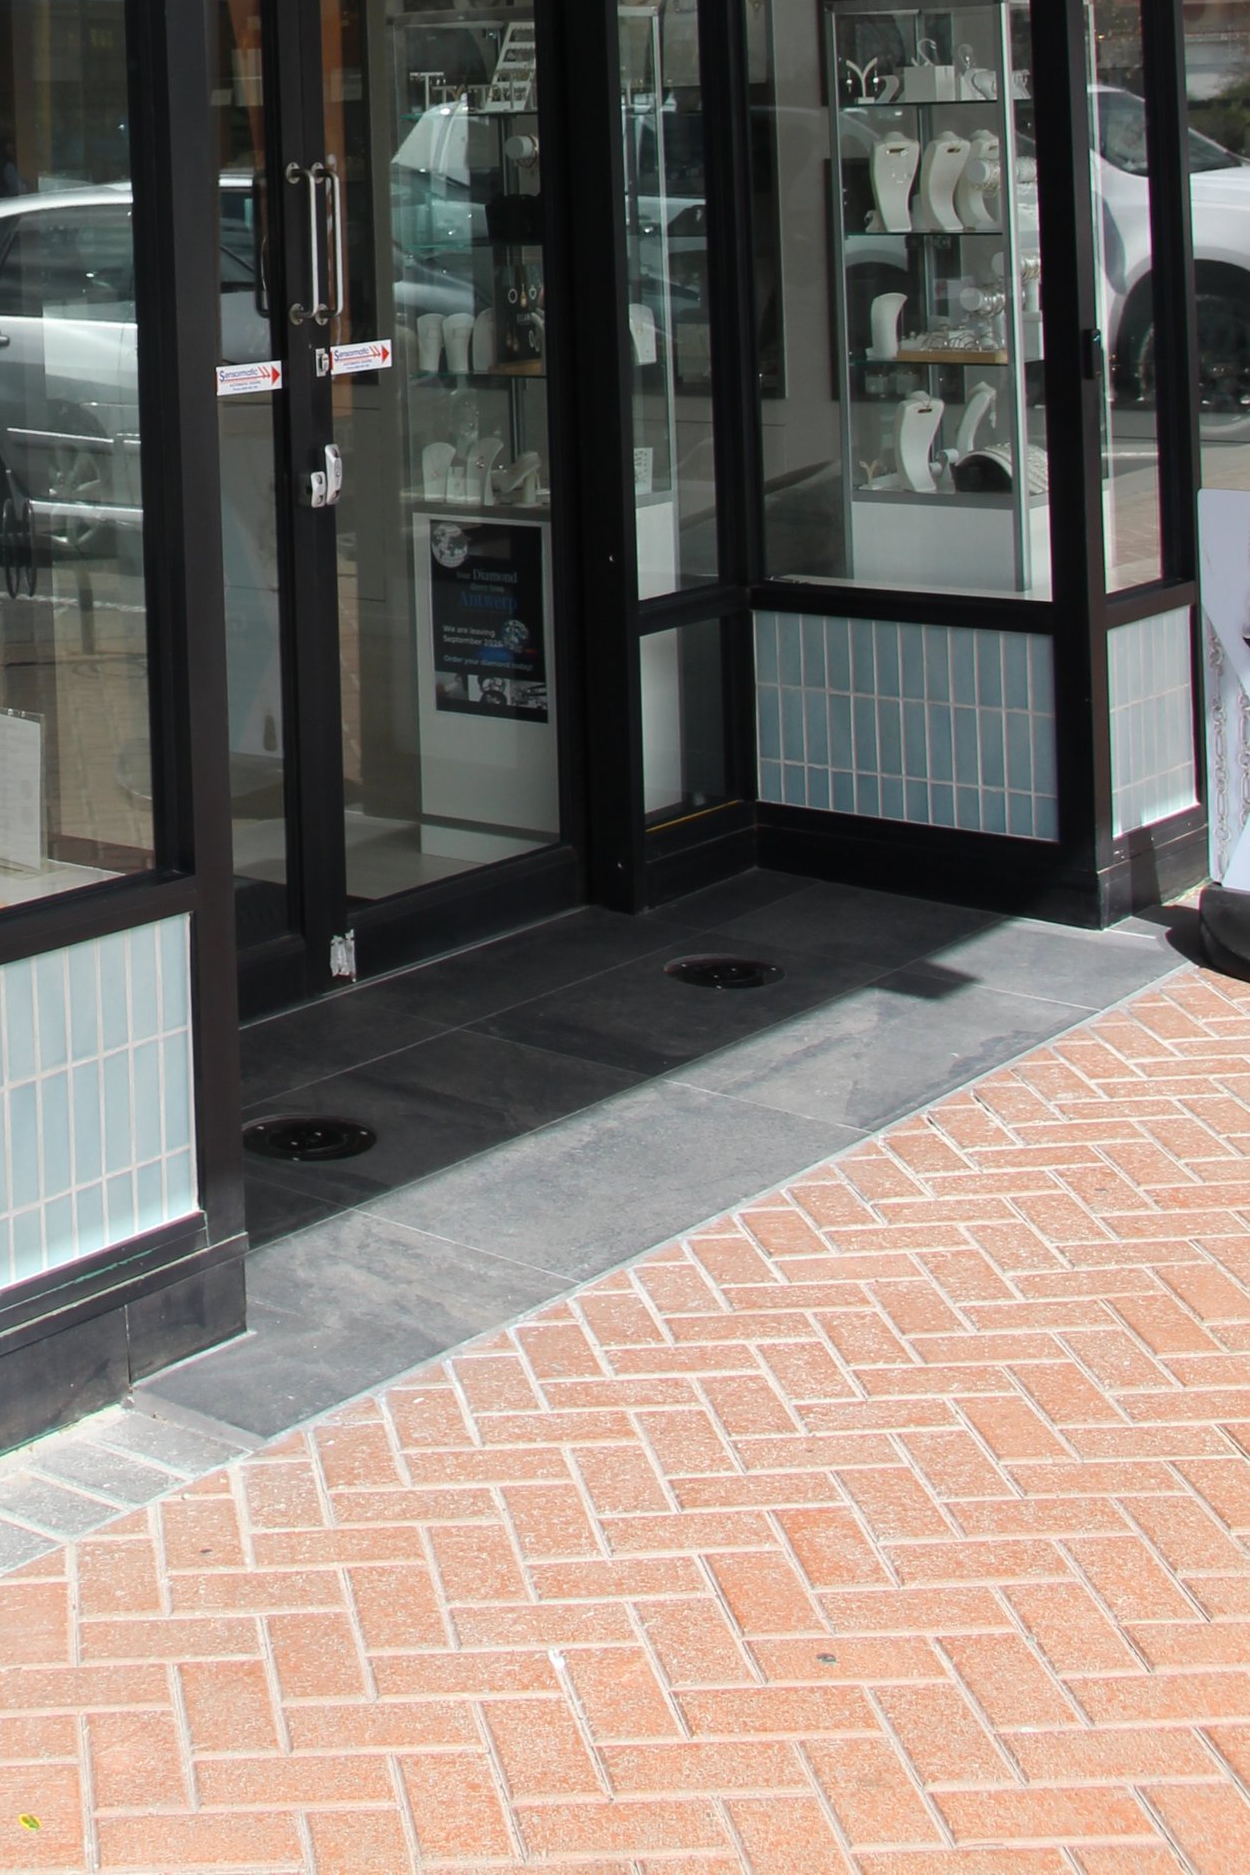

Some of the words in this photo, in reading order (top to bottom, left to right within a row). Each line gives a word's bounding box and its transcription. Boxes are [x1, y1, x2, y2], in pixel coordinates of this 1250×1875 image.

[472, 568, 518, 584] Diamond
[460, 591, 518, 614] Antwerp
[442, 624, 456, 632] We
[469, 627, 496, 638] leaving
[442, 635, 482, 646] September
